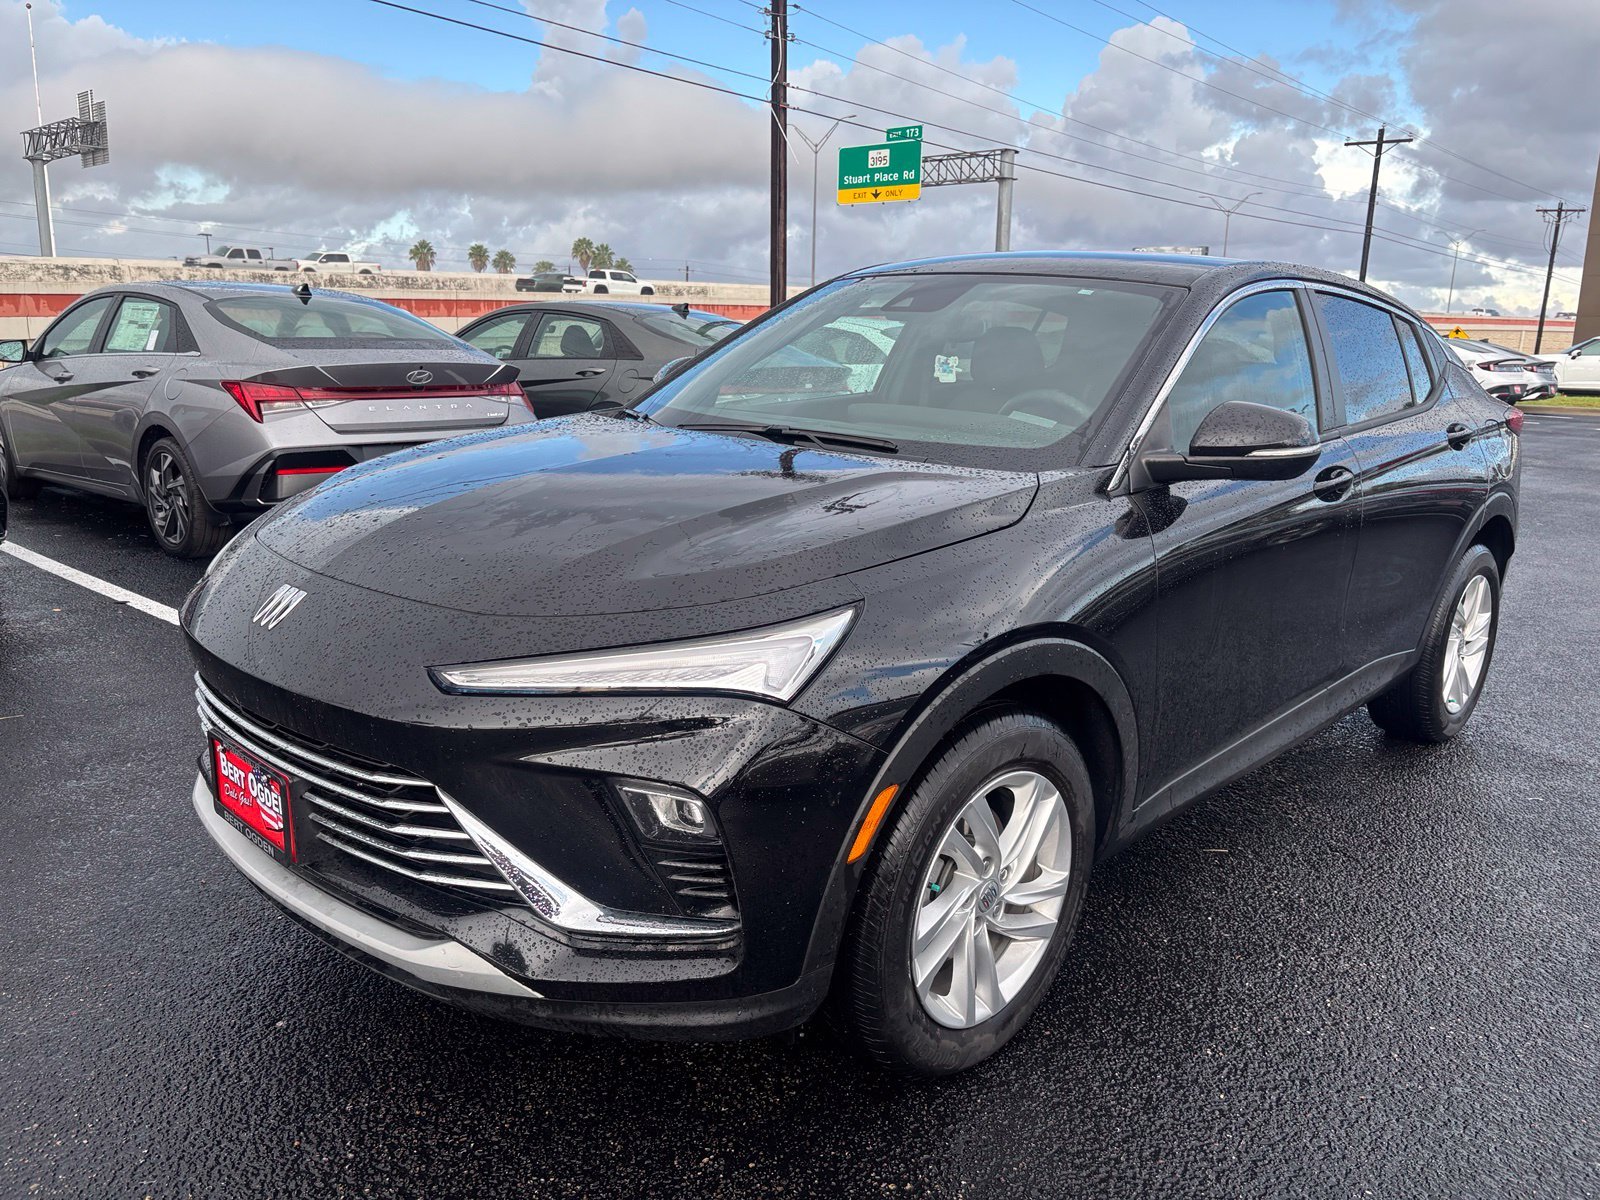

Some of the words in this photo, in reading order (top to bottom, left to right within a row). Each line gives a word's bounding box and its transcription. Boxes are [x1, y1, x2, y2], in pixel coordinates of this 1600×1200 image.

[906, 128, 919, 138] 173
[870, 156, 888, 166] 3195
[844, 174, 870, 184] Stuart
[874, 172, 899, 182] Place
[903, 170, 915, 180] Rd
[885, 189, 904, 197] ONLY
[368, 403, 473, 412] ELANTRA
[219, 751, 246, 790] BERT
[224, 810, 244, 832] BERT
[245, 828, 275, 858] OGDEN
